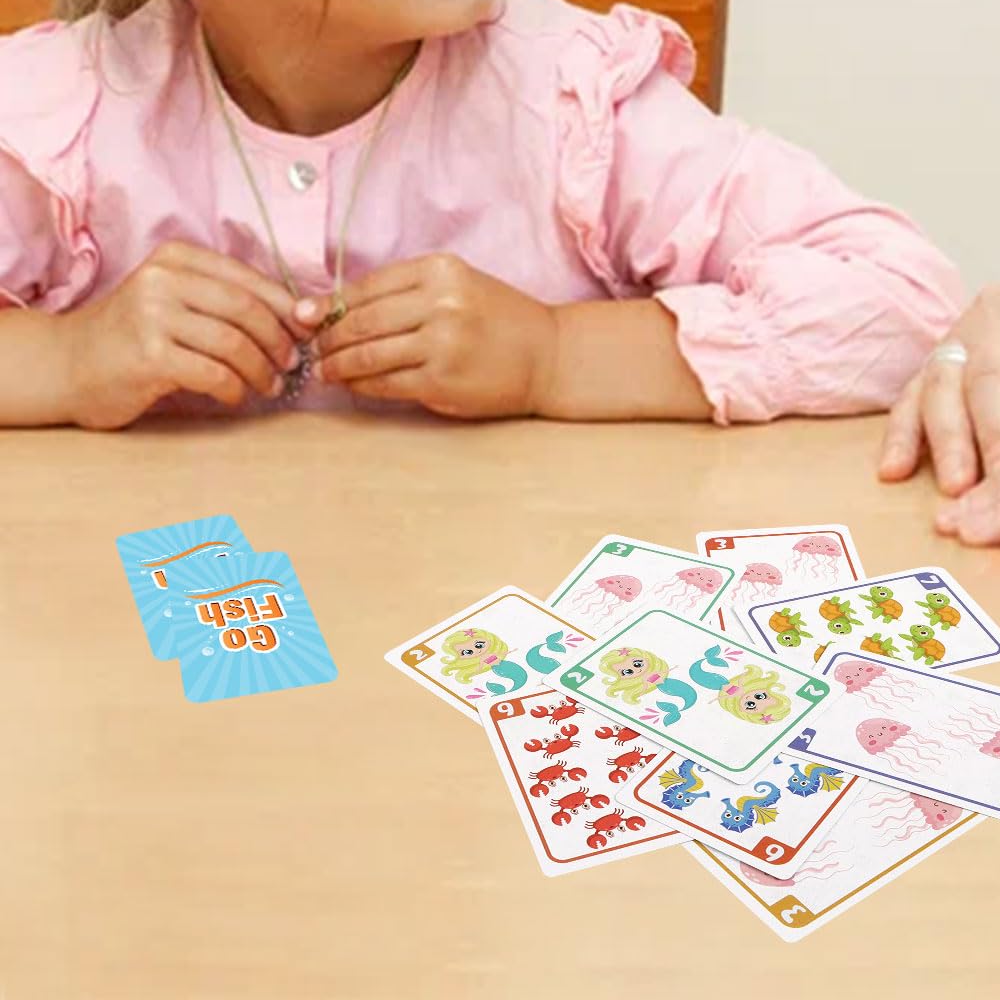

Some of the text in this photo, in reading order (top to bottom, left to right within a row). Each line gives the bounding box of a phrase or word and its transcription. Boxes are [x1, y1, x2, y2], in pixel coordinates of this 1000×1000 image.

[196, 592, 287, 629] Fish
[219, 623, 280, 652] Go
[409, 650, 428, 661] 2
[567, 671, 587, 684] 2
[803, 684, 825, 697] 2
[780, 904, 807, 924] 3
